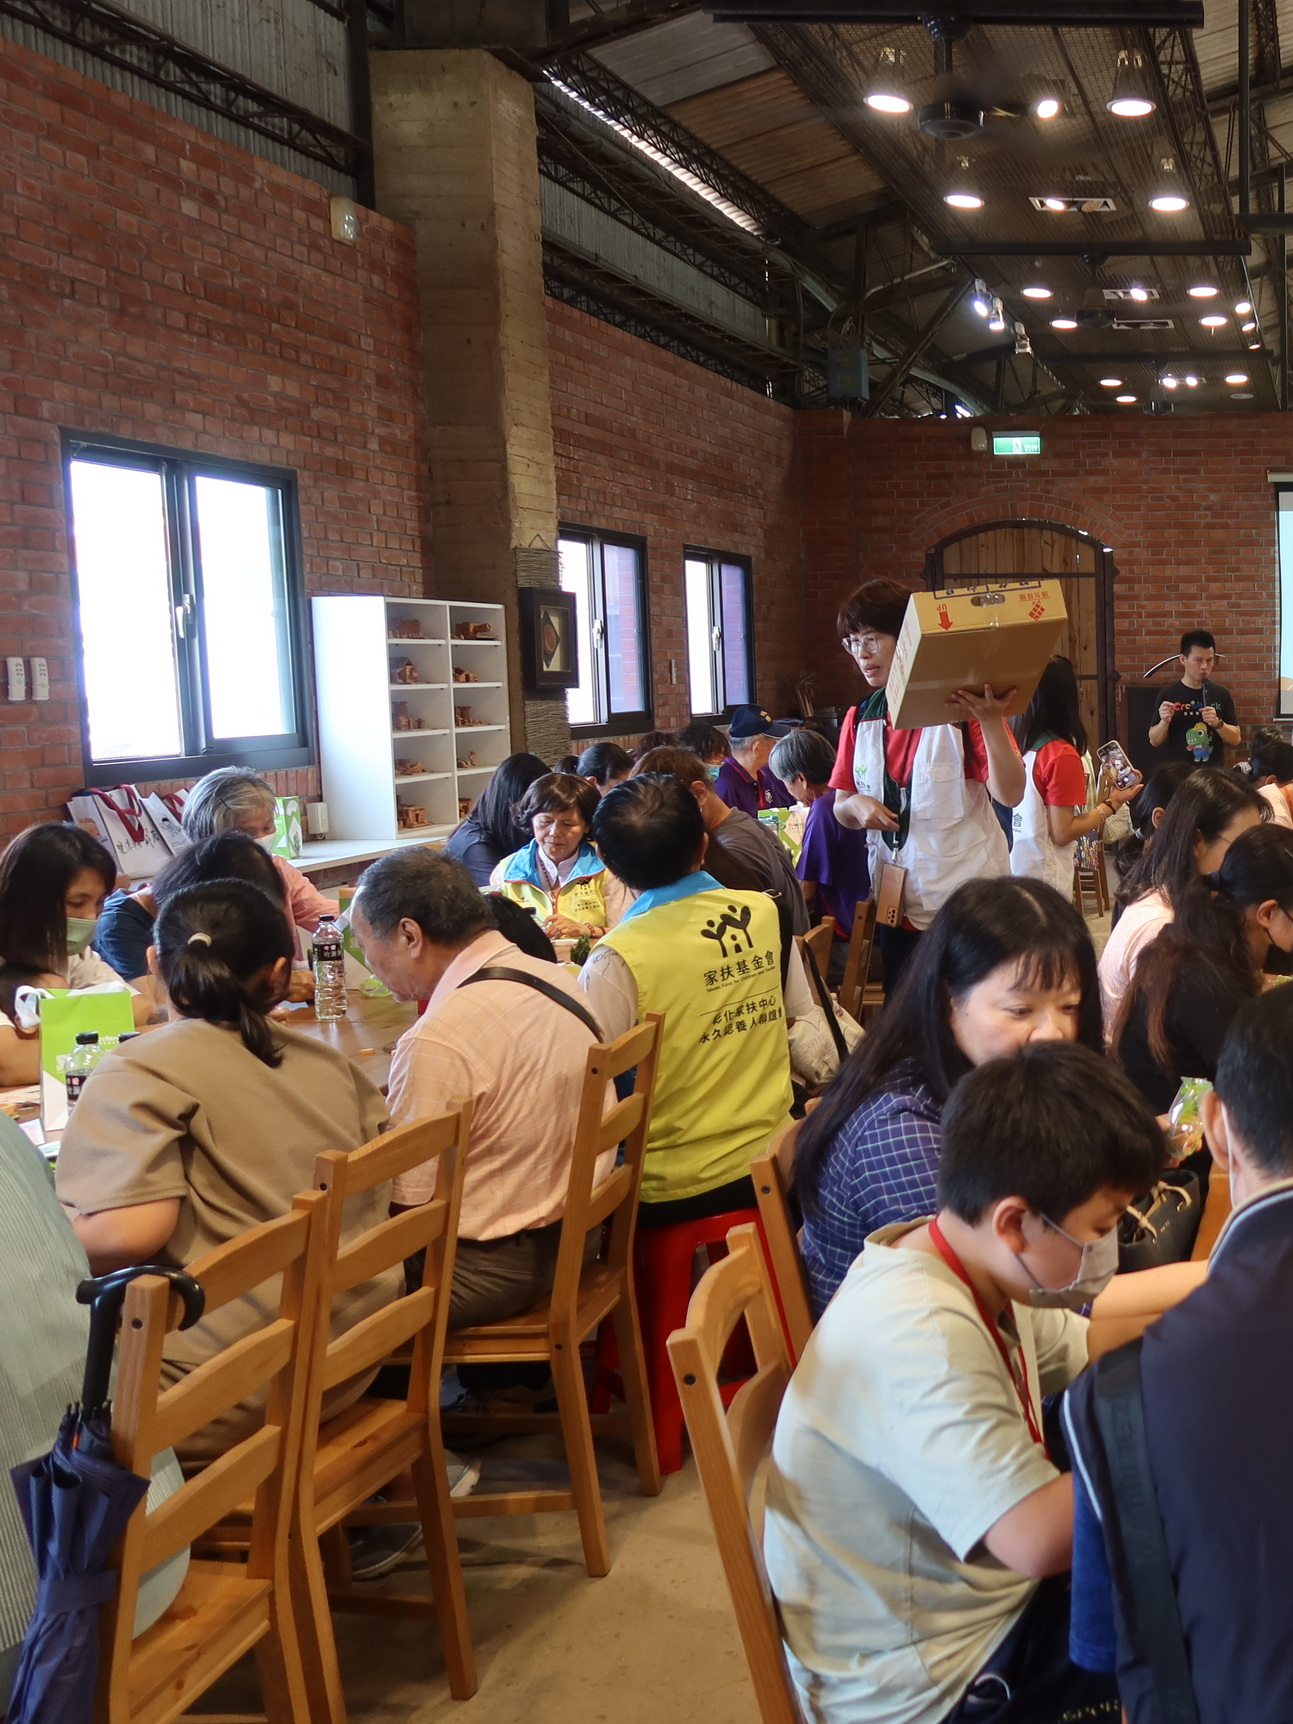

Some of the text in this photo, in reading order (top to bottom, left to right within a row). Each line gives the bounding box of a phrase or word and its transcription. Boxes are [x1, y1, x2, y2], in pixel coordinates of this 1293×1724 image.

[937, 604, 948, 612] UP
[703, 950, 774, 987] 家扶基金會
[712, 995, 777, 1026] 彰化家扶中心
